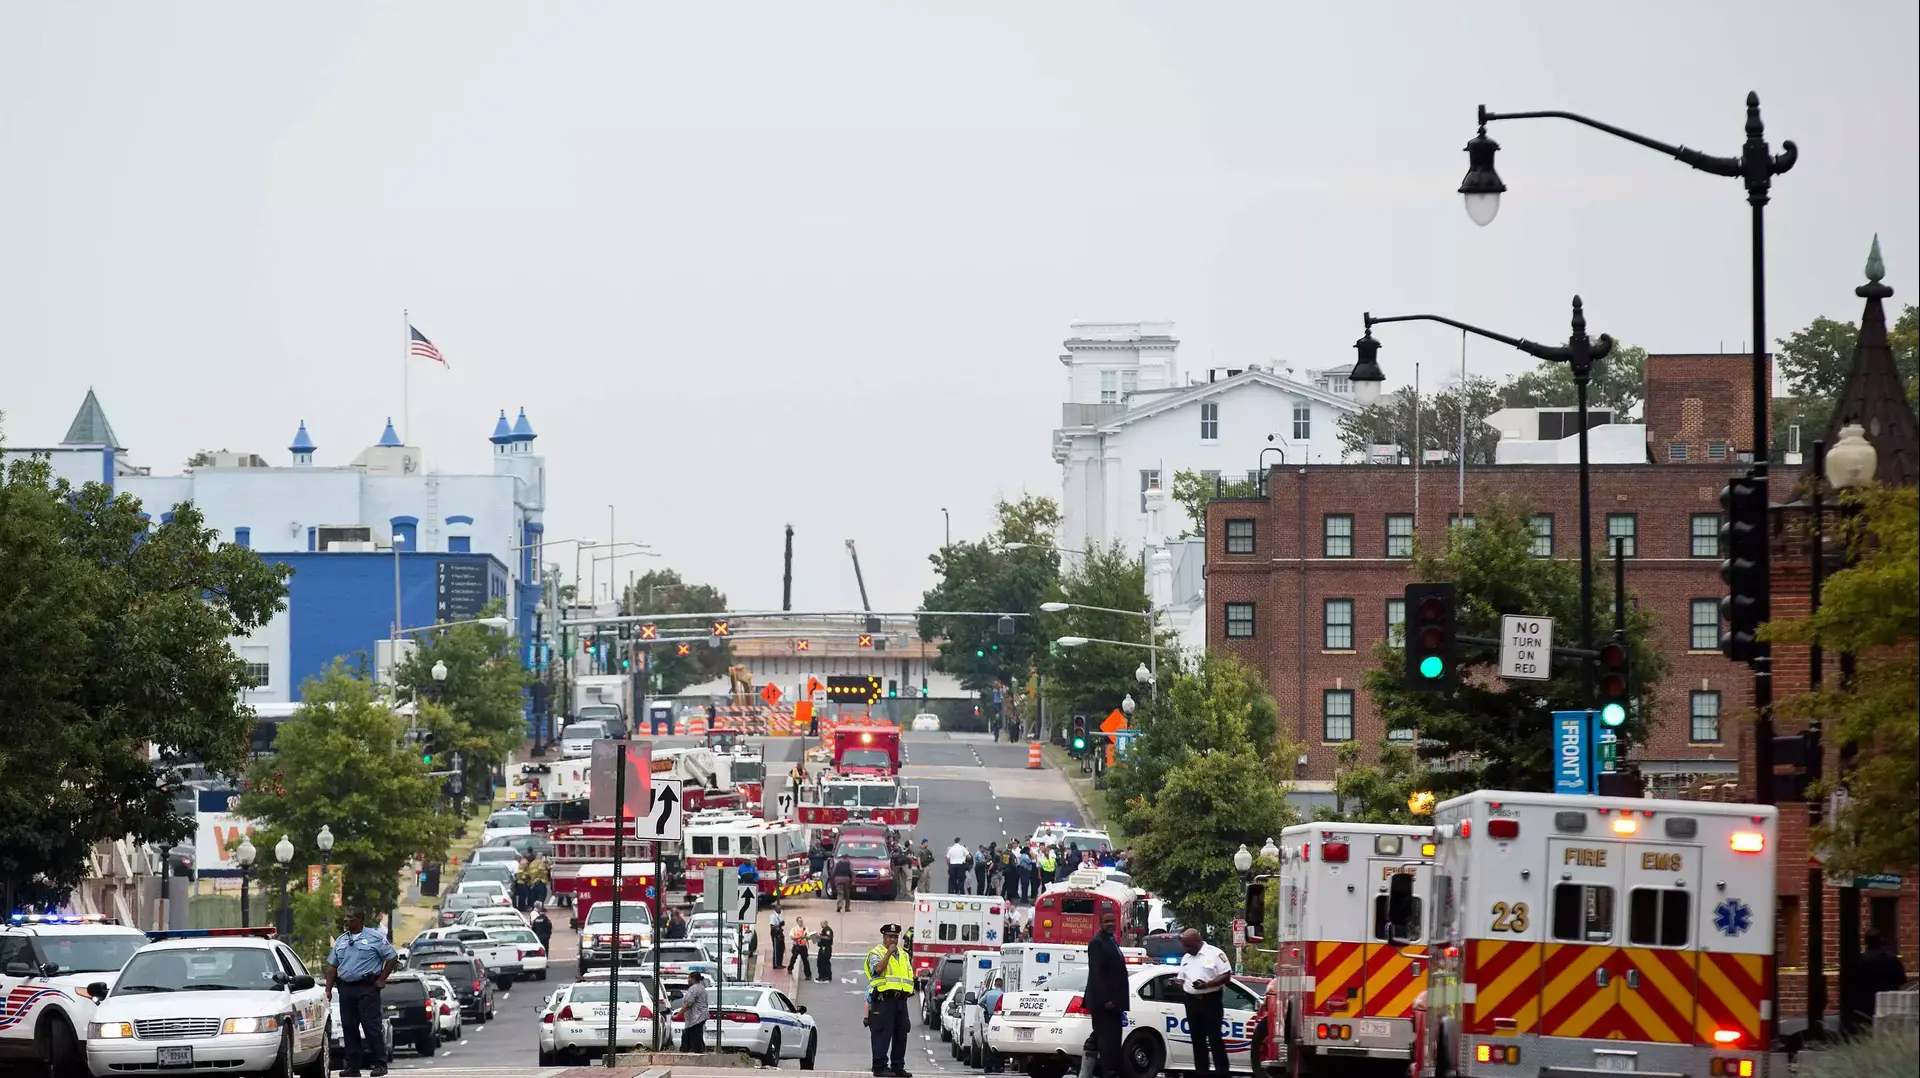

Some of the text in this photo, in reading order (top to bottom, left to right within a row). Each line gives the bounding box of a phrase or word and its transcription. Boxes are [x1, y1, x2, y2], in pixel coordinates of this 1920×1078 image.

[1516, 621, 1540, 634] NO
[1512, 636, 1542, 647] TURN
[1518, 650, 1535, 660] ON
[1515, 663, 1537, 673] RED
[1561, 725, 1580, 778] FRONT
[1564, 847, 1683, 871] FIRE EMS
[1491, 901, 1529, 933] 23
[921, 929, 932, 939] 12
[1050, 1027, 1063, 1035] 975
[1165, 1016, 1244, 1039] POCE
